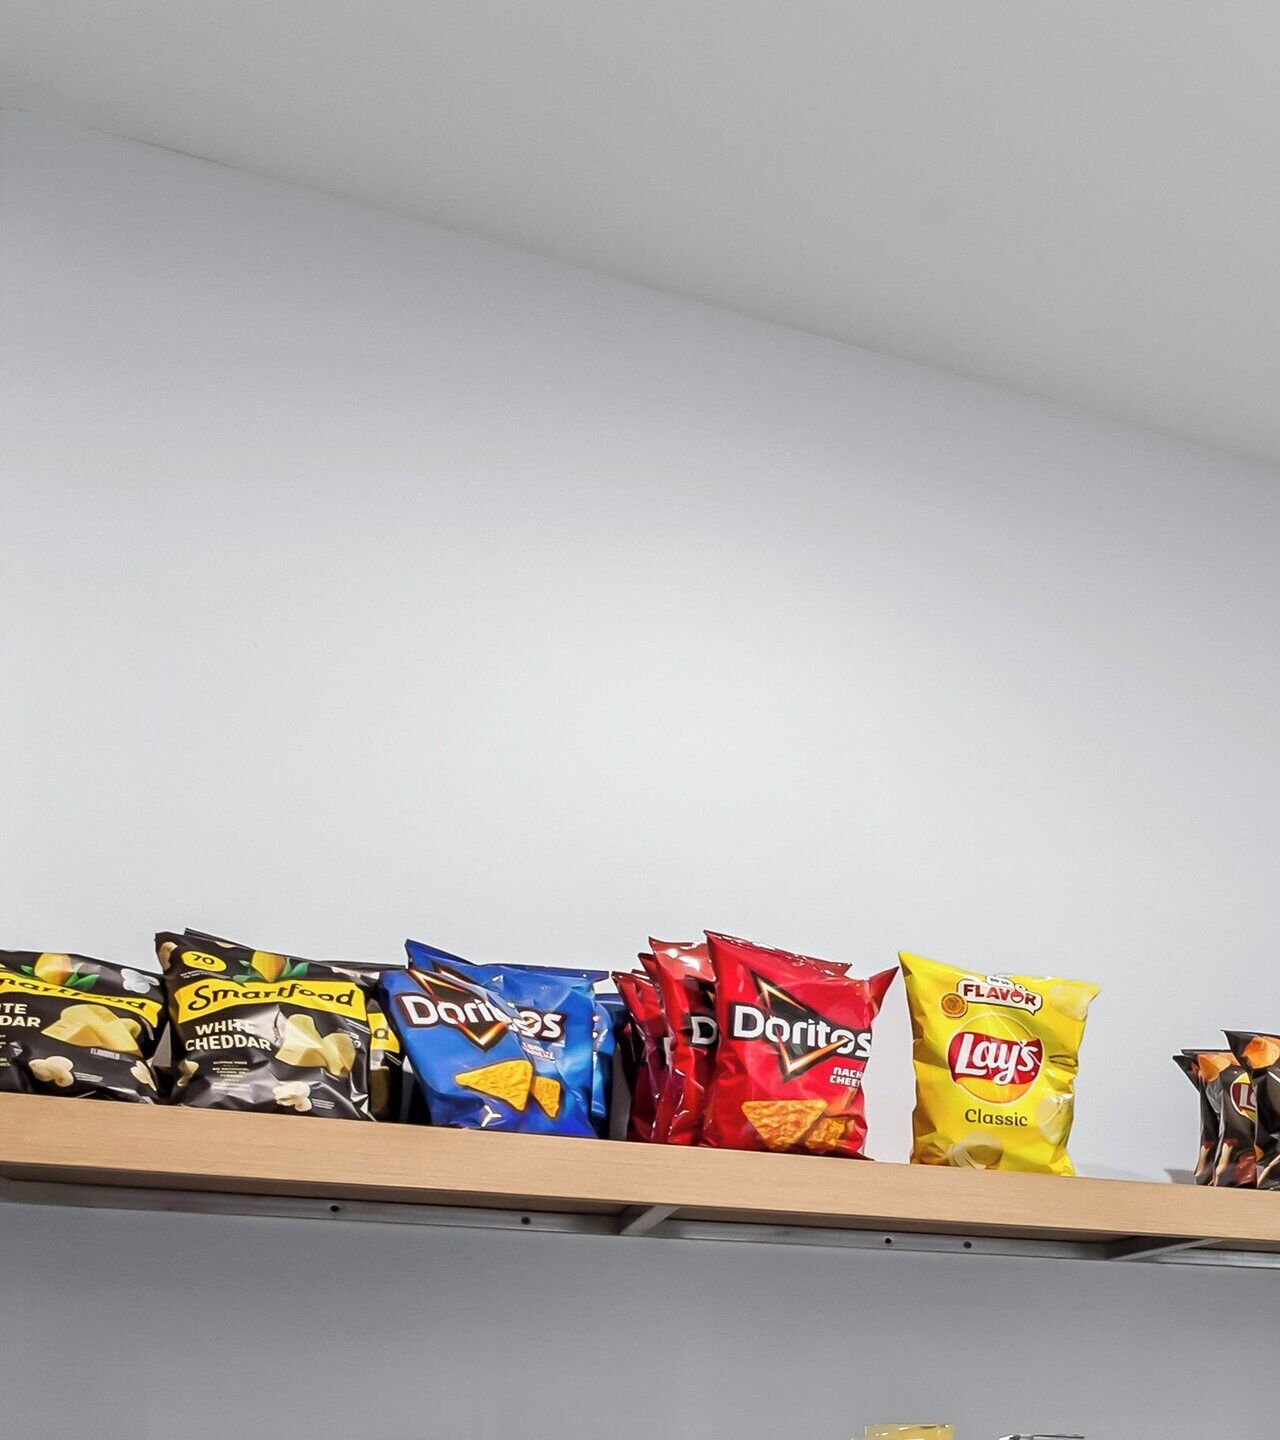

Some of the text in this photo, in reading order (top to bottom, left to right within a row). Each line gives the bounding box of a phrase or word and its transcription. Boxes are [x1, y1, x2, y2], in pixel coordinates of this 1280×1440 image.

[187, 983, 355, 1012] Smartfood
[962, 982, 1037, 1008] FLAVOR
[185, 1035, 272, 1051] CHEDDAR
[733, 1005, 872, 1057] Doritos
[954, 1032, 1040, 1083] Lay's
[833, 1067, 864, 1079] NACH
[965, 1108, 1029, 1128] Classic
